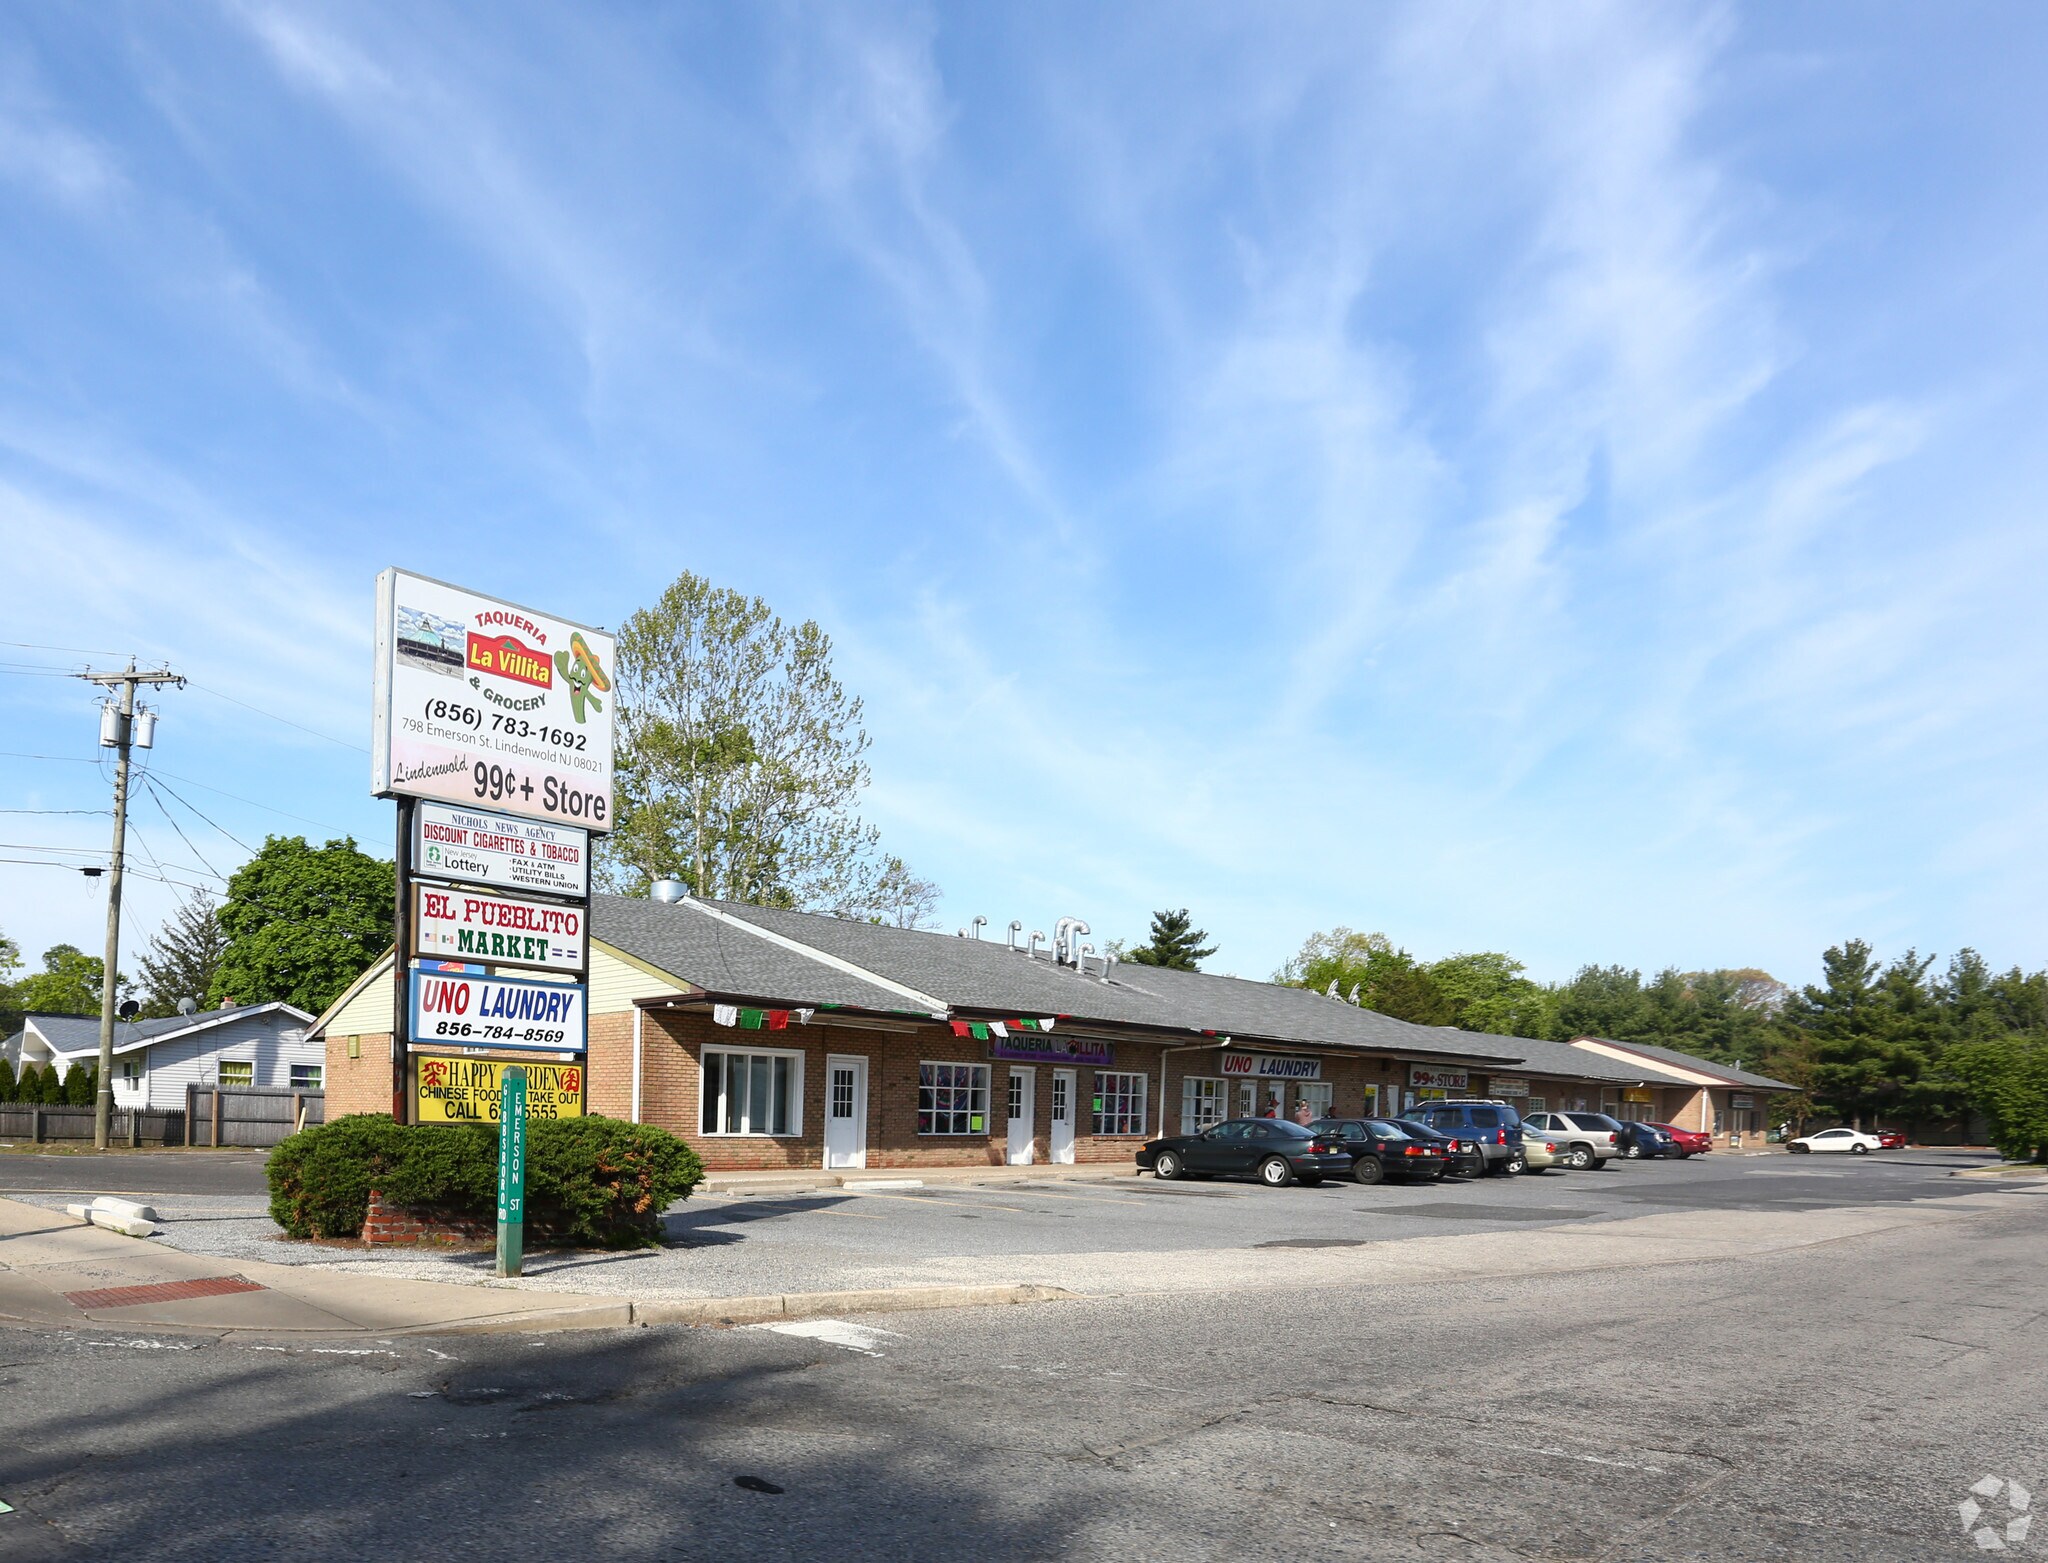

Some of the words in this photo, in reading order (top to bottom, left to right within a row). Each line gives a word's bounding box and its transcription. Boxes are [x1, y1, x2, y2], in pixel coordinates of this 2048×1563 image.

[475, 610, 547, 646] TAQUERIA
[470, 642, 492, 668] La
[498, 650, 550, 683] Villita
[469, 676, 480, 690] &
[483, 687, 546, 711] GROCERY
[425, 698, 483, 730] (856)
[491, 714, 587, 751] 783-1692
[402, 717, 424, 733] 798
[427, 723, 476, 745] Emerson
[479, 735, 492, 749] St.
[495, 736, 556, 763] Lindenwold
[559, 753, 572, 766] NJ
[574, 757, 603, 773] 08021
[394, 754, 468, 784] Lindenwold
[543, 776, 606, 821] Store
[452, 814, 488, 829] NICHOLS
[495, 822, 518, 834] NEWS
[525, 827, 556, 840] AGENCY
[424, 824, 468, 845] DISCOUNT
[473, 832, 525, 854] CIGARETTES
[530, 842, 536, 856] &
[542, 844, 578, 863] TOBACCO
[445, 848, 458, 856] New
[460, 851, 478, 861] Jersey
[445, 857, 489, 876] Lottery
[512, 858, 528, 866] FAX
[536, 862, 555, 870] ATM
[512, 867, 542, 876] UTILITY
[545, 872, 565, 880] BILLS
[512, 874, 551, 885] WESTERN
[553, 882, 578, 890] UNION
[424, 893, 456, 921] EL
[464, 898, 579, 937] PUEBLITO
[458, 929, 549, 961] MARKET
[423, 980, 470, 1016] UNO
[480, 986, 574, 1023] LAUNDRY
[436, 1021, 564, 1043] 856-784-8569
[1000, 1036, 1052, 1052] TAQUERIA
[449, 1062, 497, 1087] HAPPY
[525, 1066, 561, 1090] RDEN
[1224, 1055, 1253, 1073] UNO
[1259, 1057, 1319, 1078] LAUNDRY
[1437, 1073, 1466, 1087] STORE
[420, 1086, 468, 1100] CHINESE
[529, 1091, 554, 1103] TAKE
[558, 1093, 579, 1104] OUT
[445, 1101, 482, 1119] CALL
[500, 1084, 508, 1205] GIBBSBORO
[512, 1093, 521, 1184] EMERSON
[499, 1208, 507, 1220] RD
[510, 1199, 520, 1210] ST
